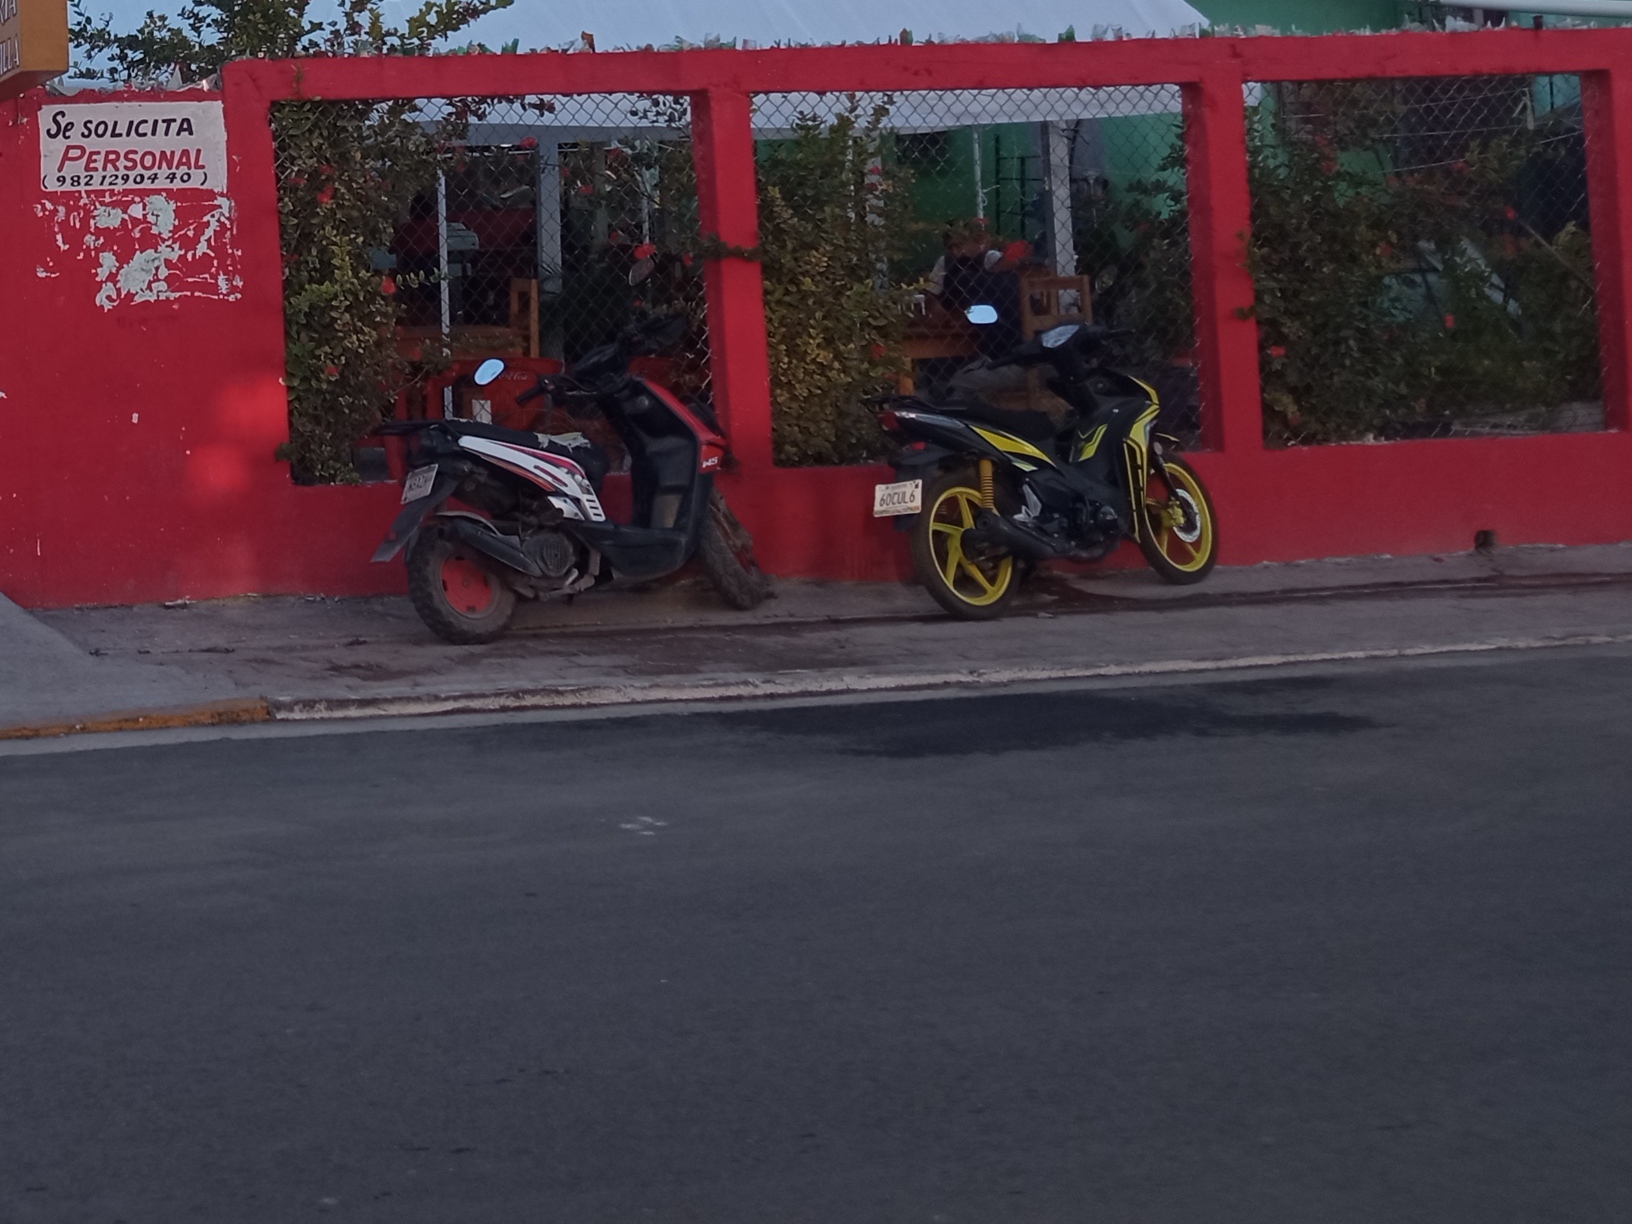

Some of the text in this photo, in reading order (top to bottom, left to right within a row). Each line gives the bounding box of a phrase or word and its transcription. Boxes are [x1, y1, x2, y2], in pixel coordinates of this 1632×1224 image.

[46, 110, 194, 140] Se SOLICITA
[57, 144, 206, 173] PERSONAL
